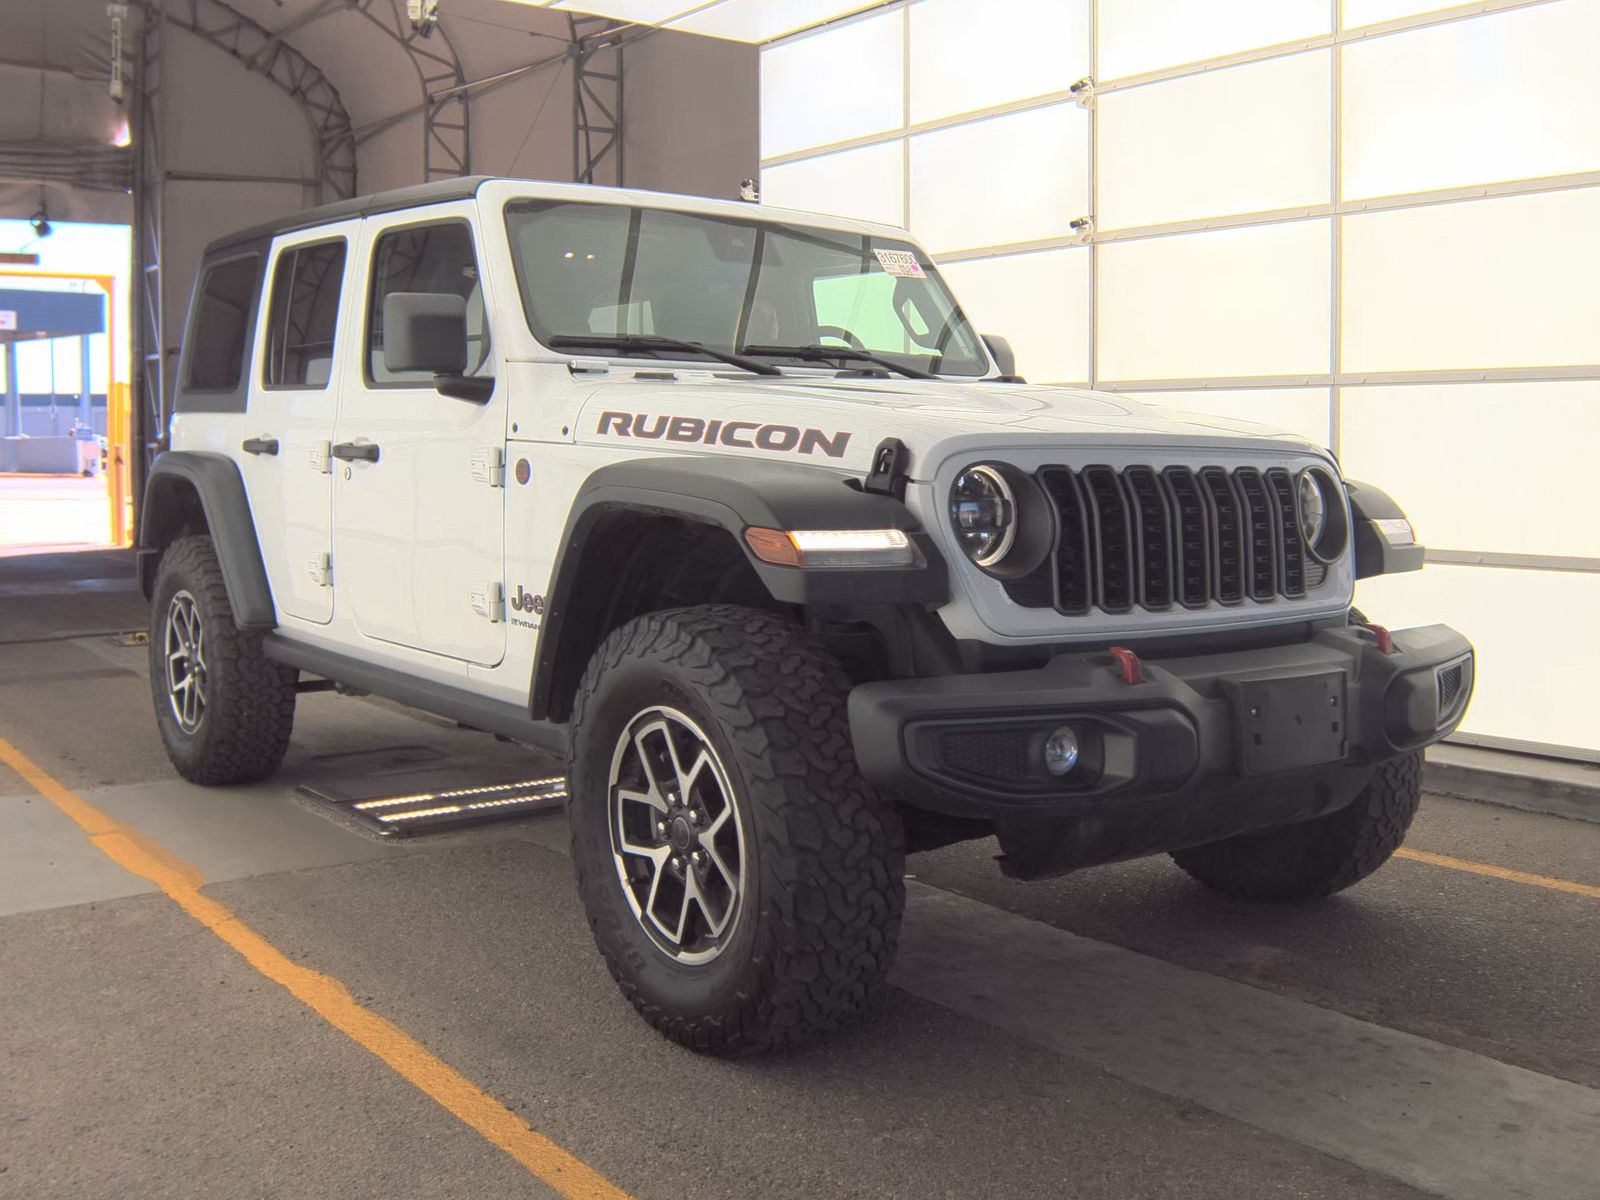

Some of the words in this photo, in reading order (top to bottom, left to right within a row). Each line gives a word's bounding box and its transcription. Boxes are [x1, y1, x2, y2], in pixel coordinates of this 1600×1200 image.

[877, 252, 918, 265] 3167600
[597, 411, 852, 457] RUBICON
[511, 585, 544, 615] Jee
